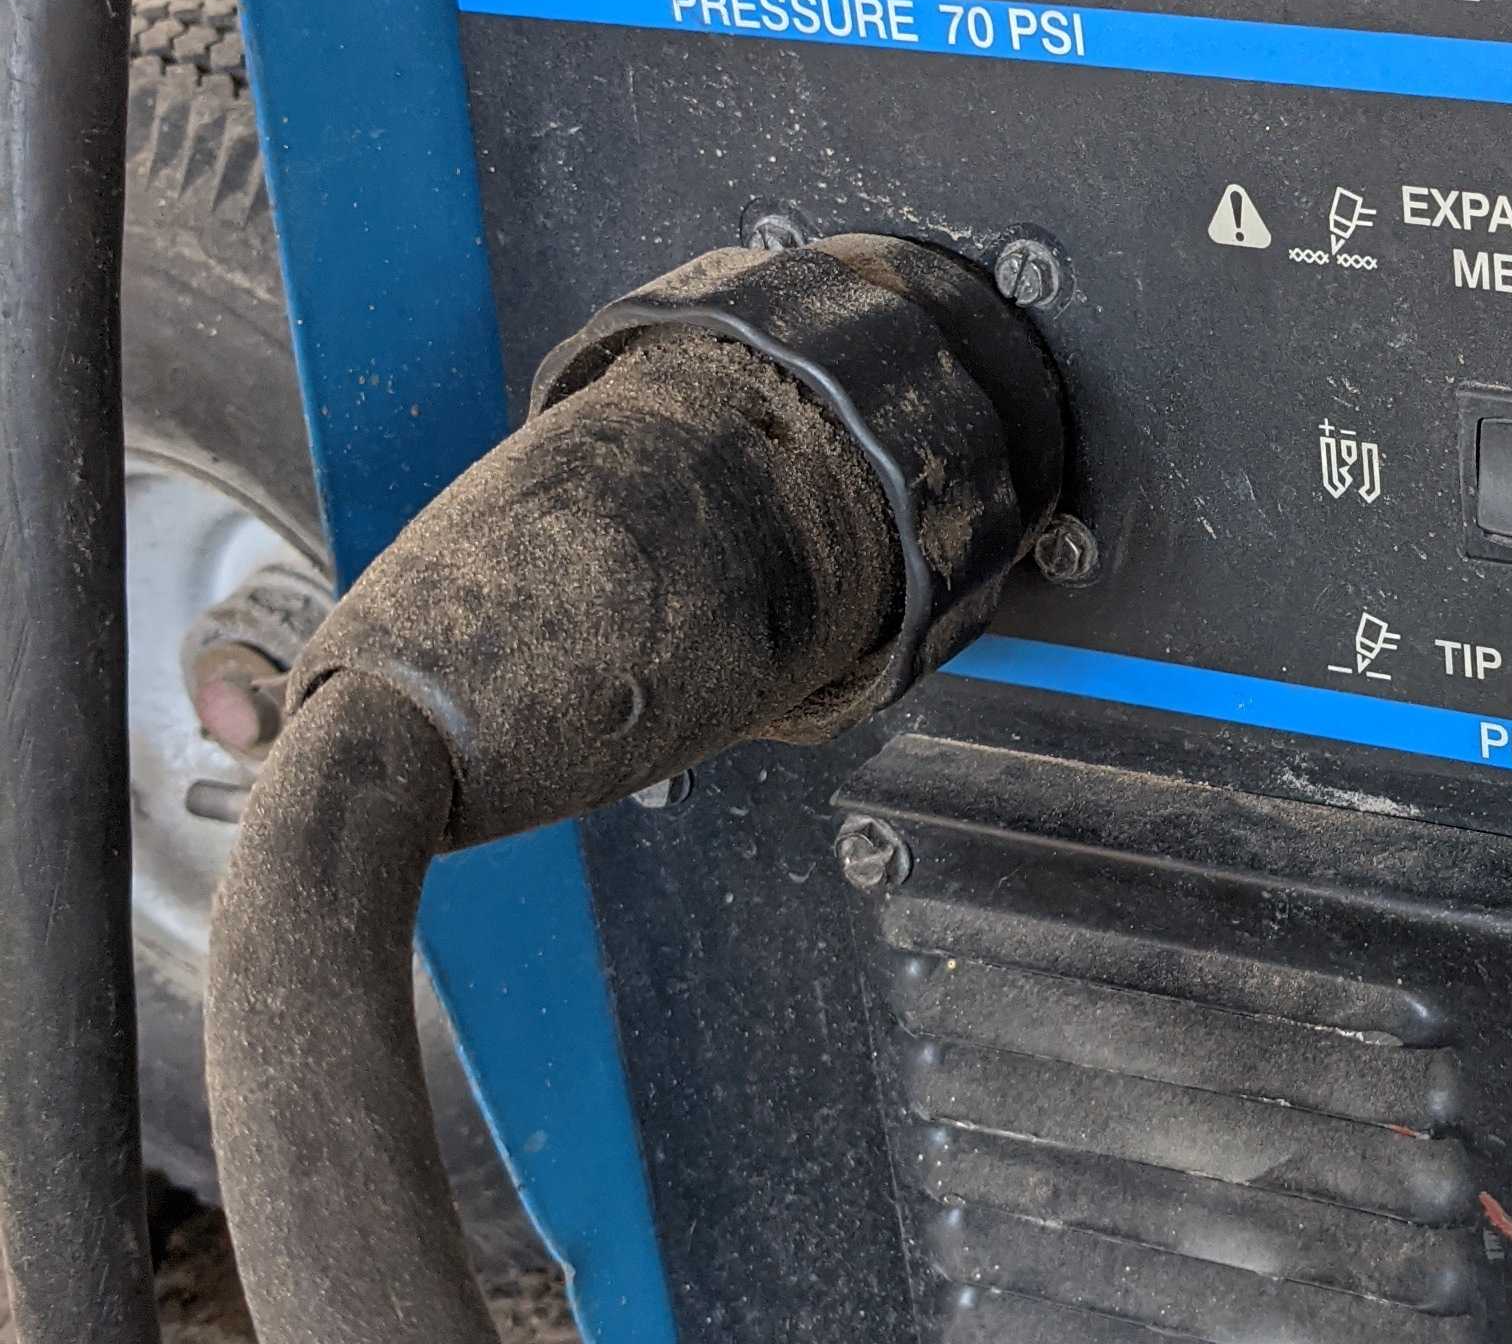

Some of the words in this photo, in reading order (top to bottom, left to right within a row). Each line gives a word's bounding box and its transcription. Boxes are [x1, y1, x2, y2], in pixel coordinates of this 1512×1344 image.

[938, 4, 994, 49] 70
[1009, 7, 1085, 56] PSI
[1434, 639, 1502, 680] TIP
